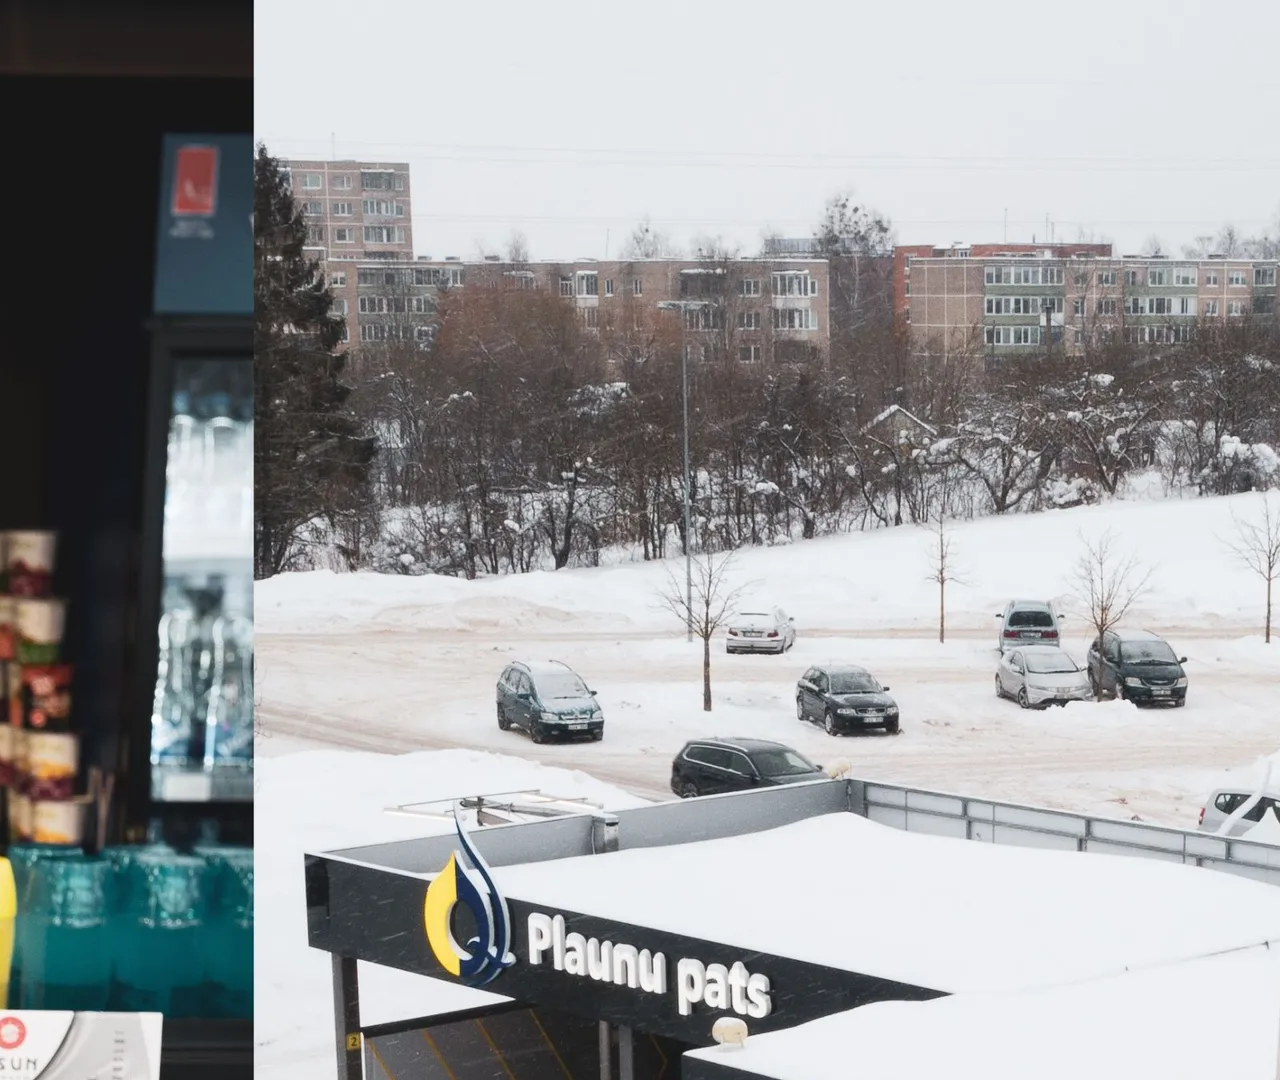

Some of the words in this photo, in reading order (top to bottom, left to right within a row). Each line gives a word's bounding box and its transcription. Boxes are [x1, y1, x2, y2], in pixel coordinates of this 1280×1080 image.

[528, 912, 666, 994] Plaunu
[677, 957, 771, 1019] pats
[351, 1036, 357, 1046] 2
